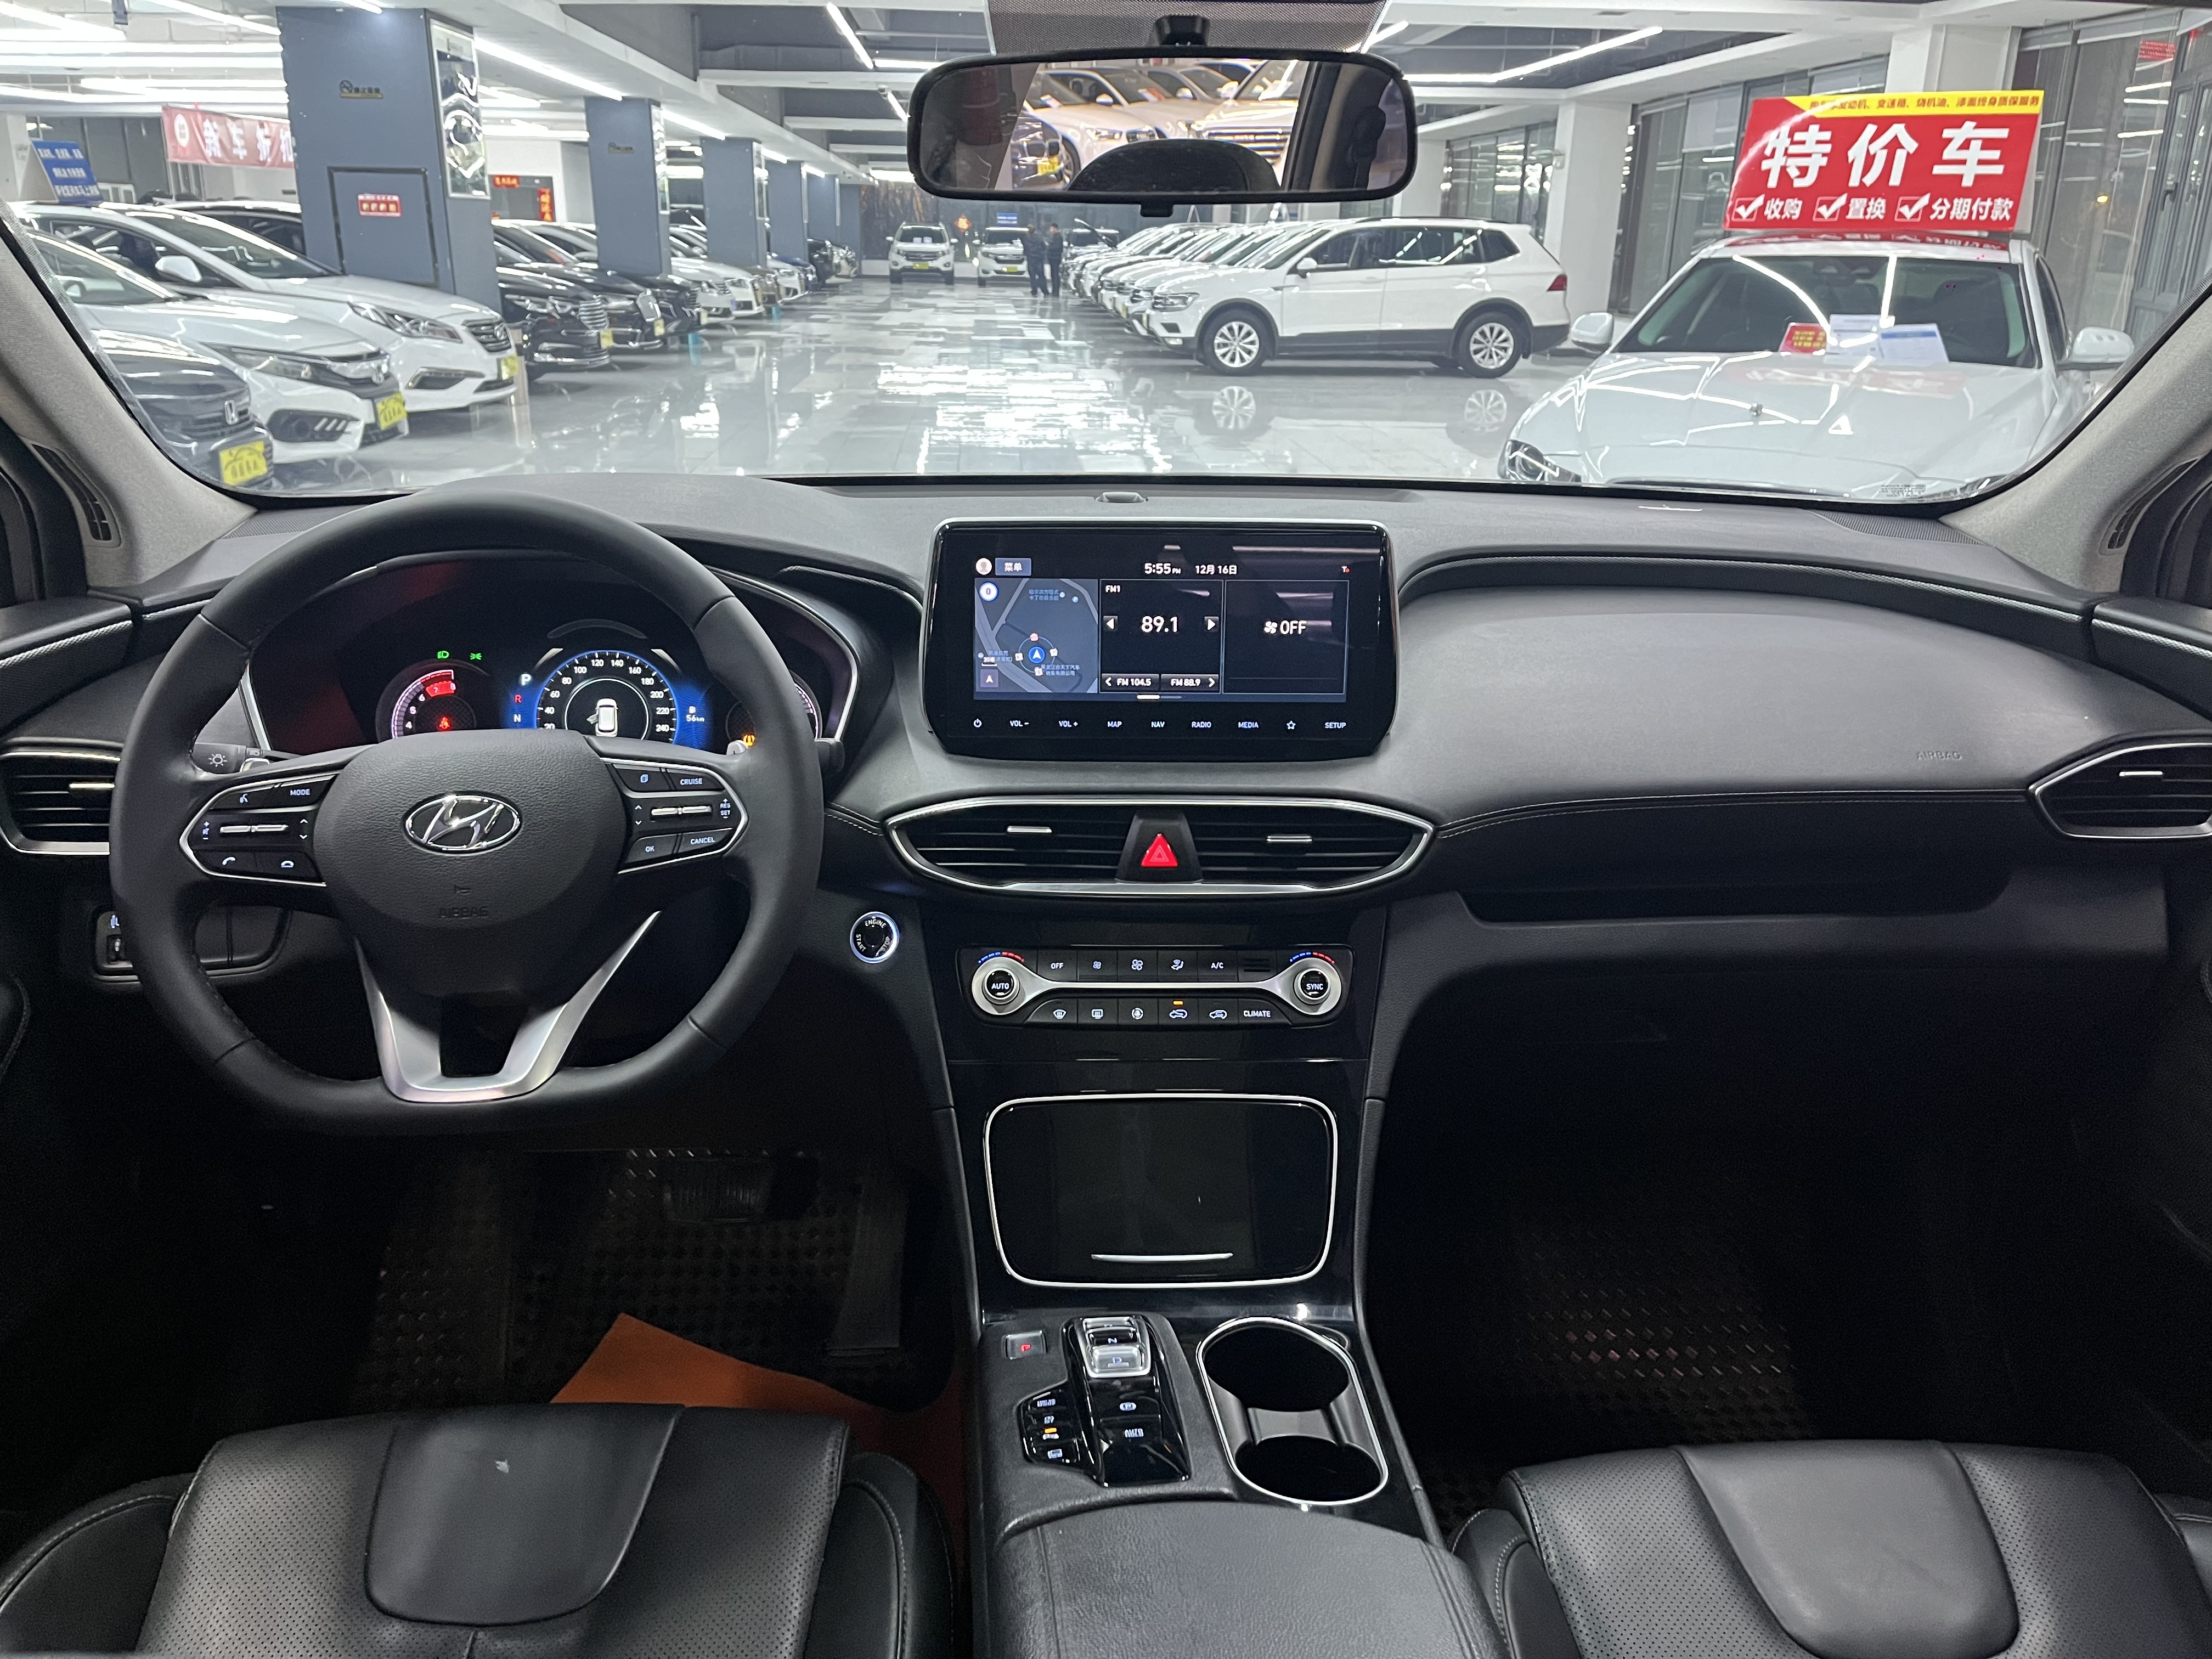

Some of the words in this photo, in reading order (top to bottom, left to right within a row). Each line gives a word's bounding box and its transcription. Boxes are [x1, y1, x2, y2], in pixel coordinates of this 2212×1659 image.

[1760, 120, 2010, 188] 特价车
[1764, 198, 1803, 220] 收购
[1846, 198, 1886, 219] 置换
[1930, 198, 2013, 221] 分期付款
[1004, 562, 1023, 572] 菜单
[1144, 563, 1171, 574] 5:55
[1195, 565, 1215, 575] 12月
[1217, 565, 1238, 575] 16日
[1105, 585, 1121, 593] FM1
[1141, 616, 1178, 633] 89.1
[1280, 620, 1307, 635] OFF
[521, 673, 531, 686] P
[1117, 678, 1129, 686] FM
[1130, 678, 1152, 686] 104.5
[1171, 678, 1183, 686] FM
[515, 695, 521, 703] R
[409, 706, 416, 714] 5
[514, 714, 521, 722] N
[1917, 751, 1962, 761] AIRBAG
[690, 837, 715, 845] CANCEL
[865, 918, 887, 929] ENGINE
[856, 934, 866, 952] START
